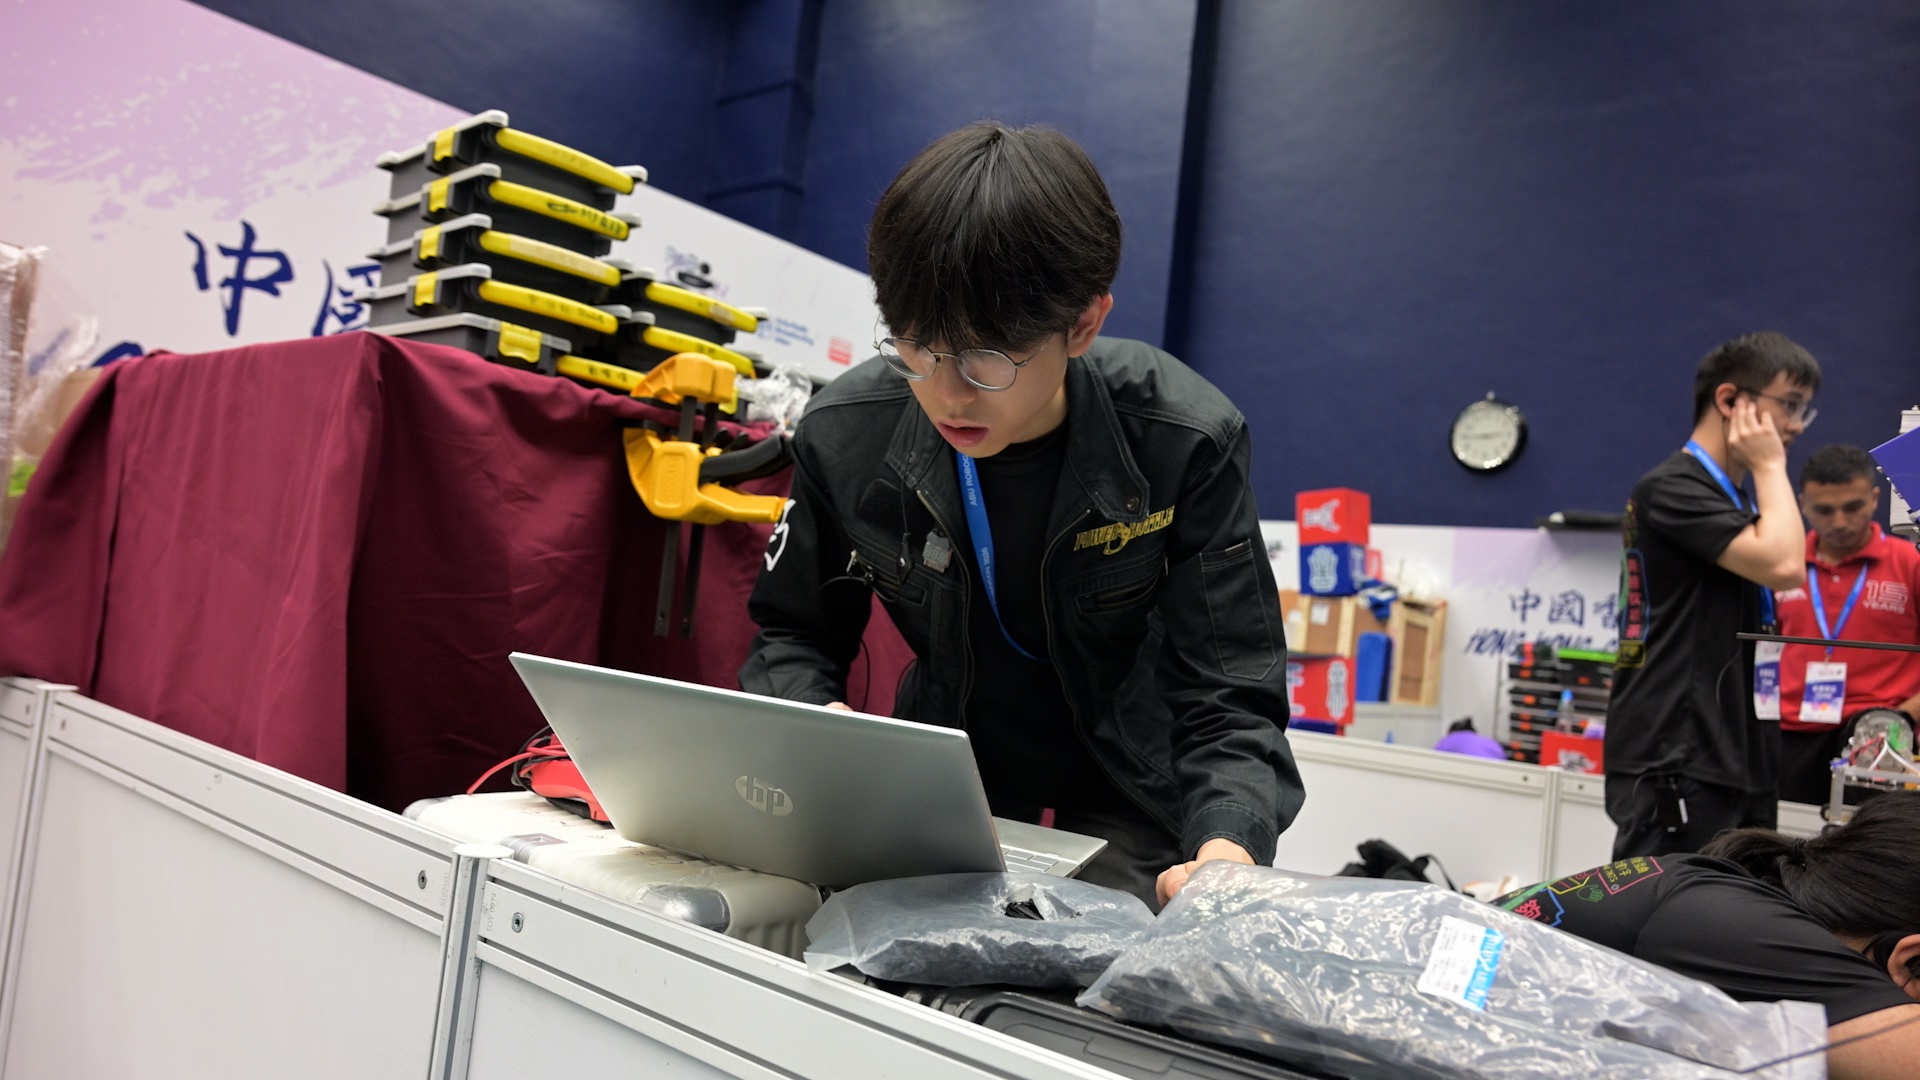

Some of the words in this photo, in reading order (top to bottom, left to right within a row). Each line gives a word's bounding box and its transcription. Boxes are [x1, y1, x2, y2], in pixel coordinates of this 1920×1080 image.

[968, 486, 978, 507] ABU
[1073, 522, 1120, 551] POWER
[1865, 579, 1909, 605] 15
[1862, 600, 1906, 615] YEARS
[746, 775, 786, 816] hp
